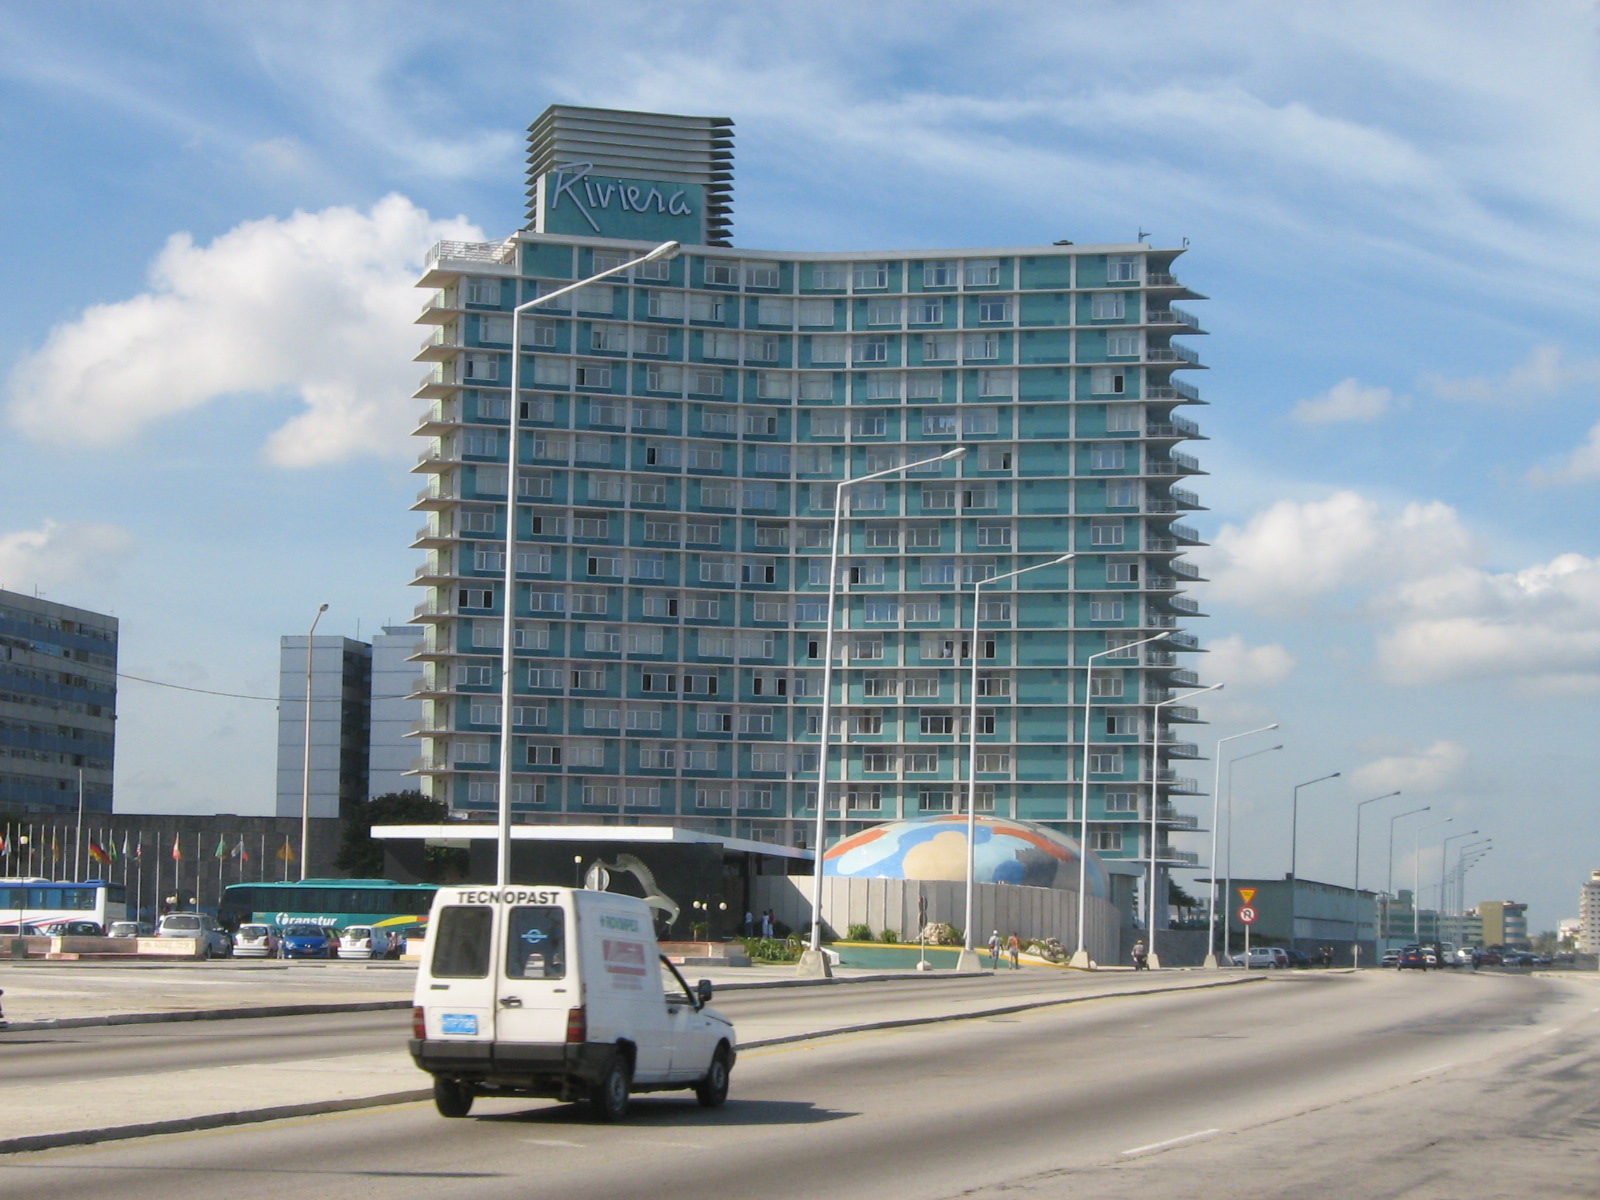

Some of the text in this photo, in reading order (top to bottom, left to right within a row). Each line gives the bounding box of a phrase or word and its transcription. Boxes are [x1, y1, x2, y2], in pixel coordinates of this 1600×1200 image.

[551, 160, 692, 233] Riviera
[457, 890, 560, 905] TECNOPAST
[275, 911, 338, 926] transtur
